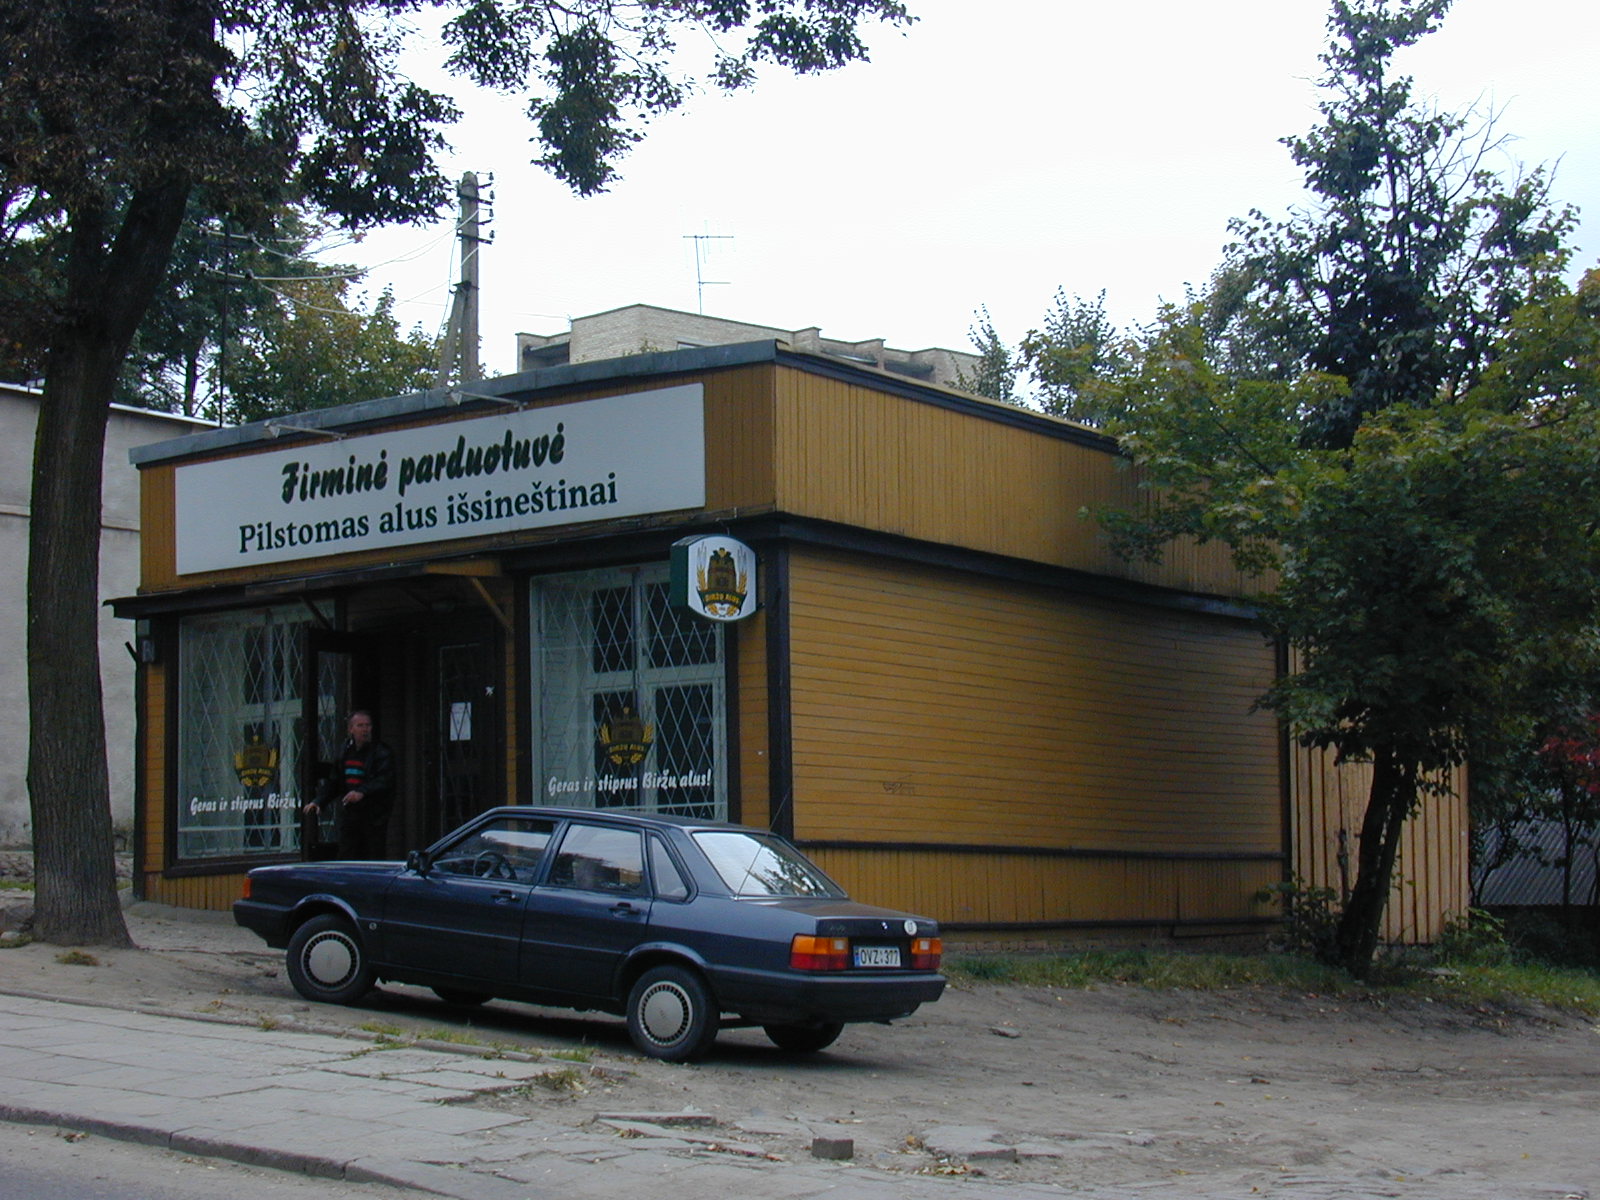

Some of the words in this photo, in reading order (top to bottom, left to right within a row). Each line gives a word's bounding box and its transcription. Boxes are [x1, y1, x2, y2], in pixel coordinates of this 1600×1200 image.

[281, 449, 388, 505] Firminė
[398, 422, 566, 496] parduotuvė
[238, 514, 370, 553] Pilstomas
[378, 502, 438, 533] alus
[447, 472, 618, 525] išsineštinai
[190, 796, 217, 815] Geras
[219, 797, 229, 811] ir
[231, 795, 264, 814] stiprus
[548, 776, 580, 796] Geras
[583, 776, 594, 791] ir
[597, 774, 638, 795] stiprus
[679, 768, 712, 787] alus!
